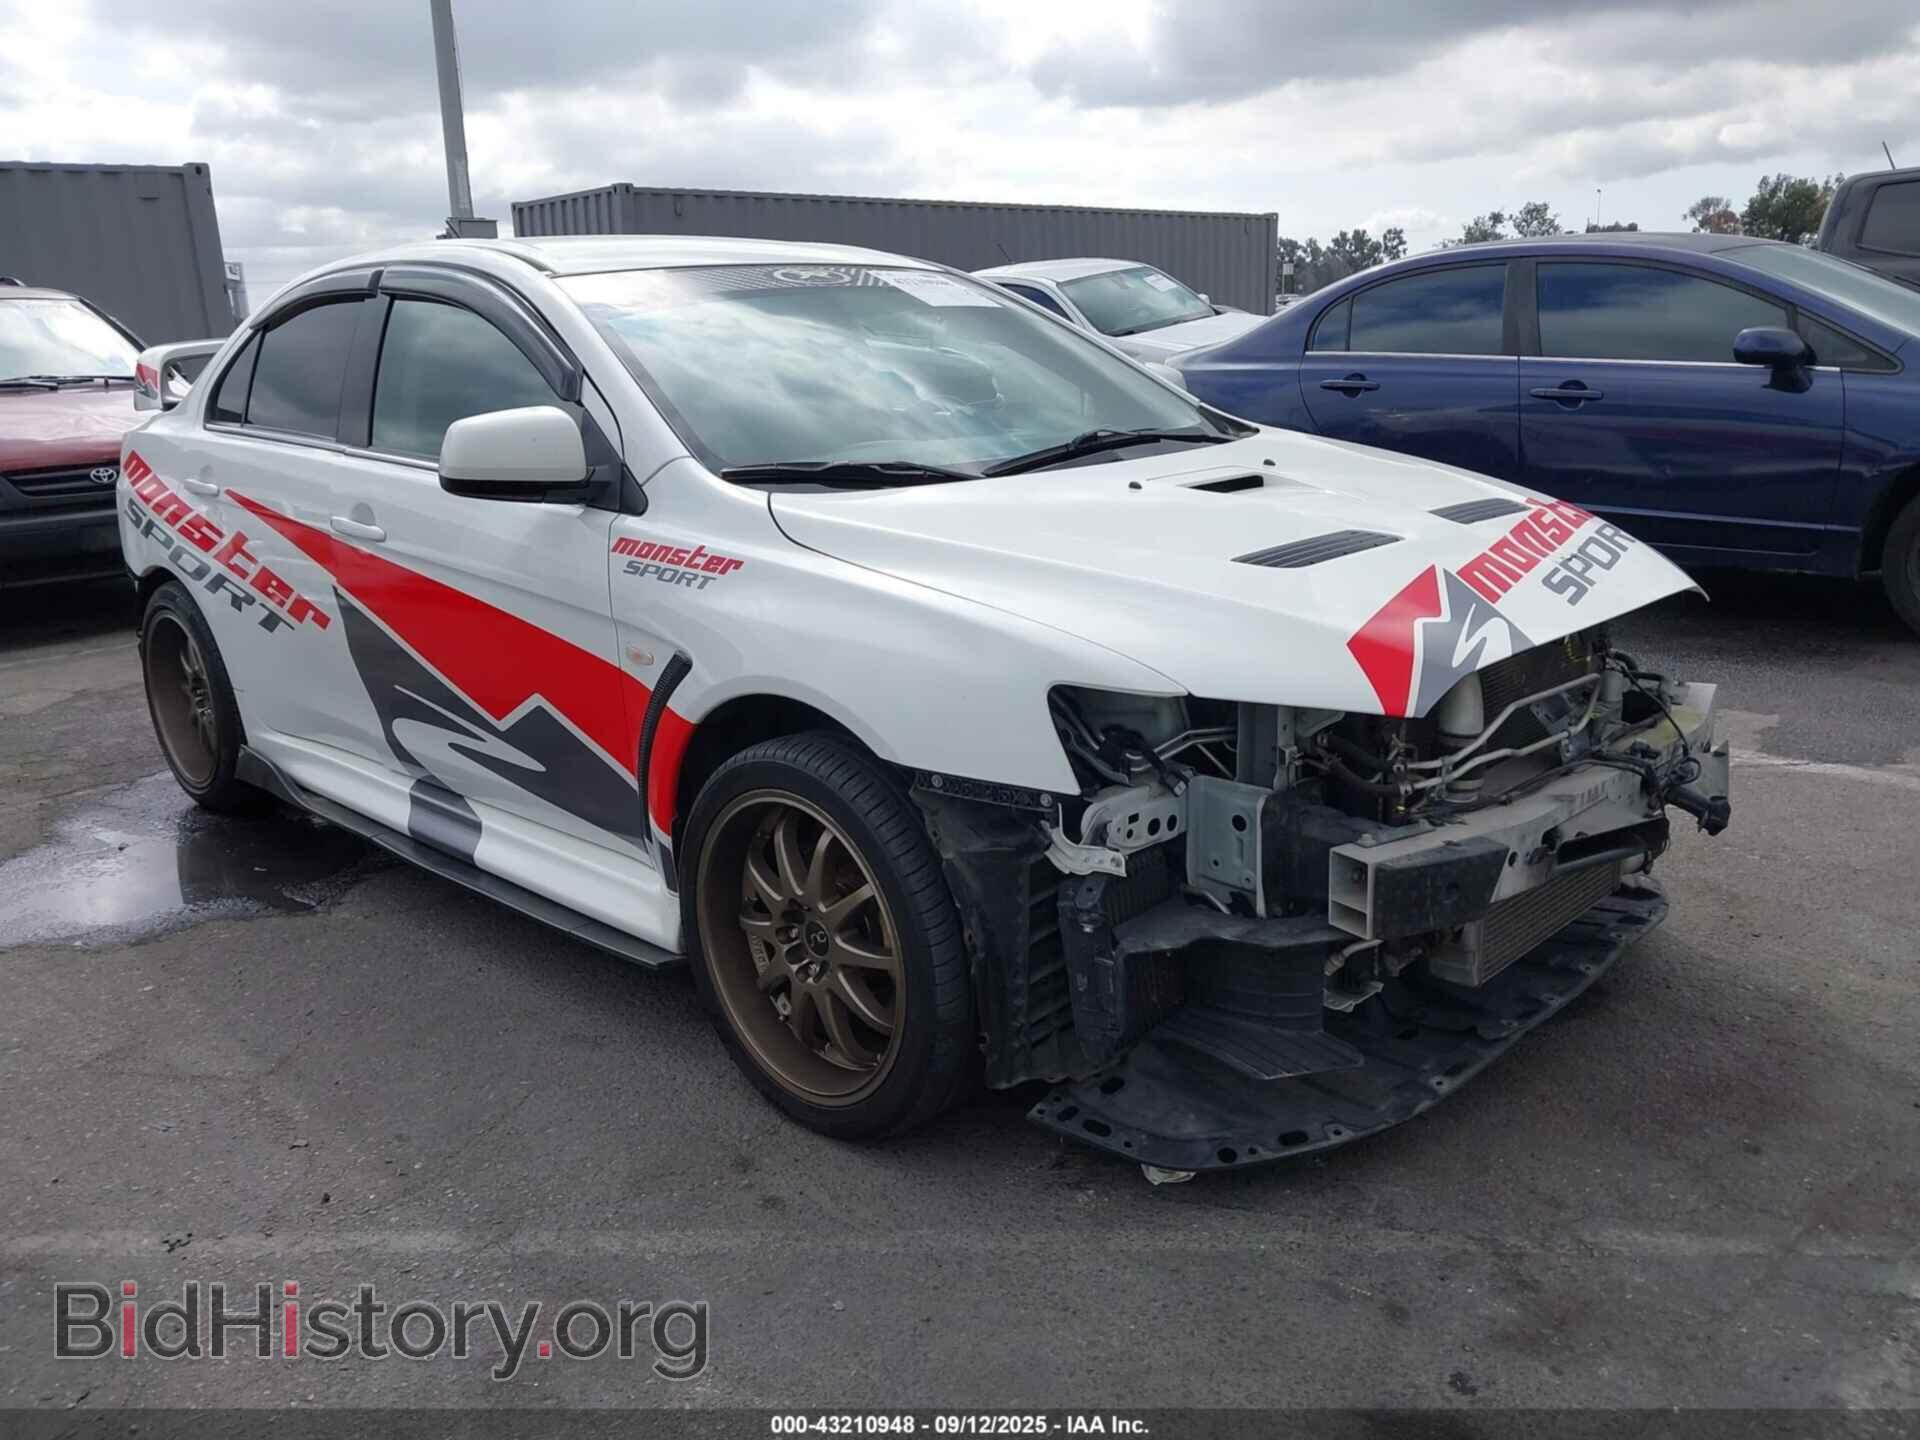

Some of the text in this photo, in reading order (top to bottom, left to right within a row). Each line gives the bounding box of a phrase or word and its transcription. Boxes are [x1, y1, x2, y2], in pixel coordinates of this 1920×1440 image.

[122, 449, 332, 631] monster
[123, 497, 296, 633] SPORT
[610, 536, 745, 576] monster
[622, 559, 718, 590] SPORT
[1456, 497, 1594, 605] monst
